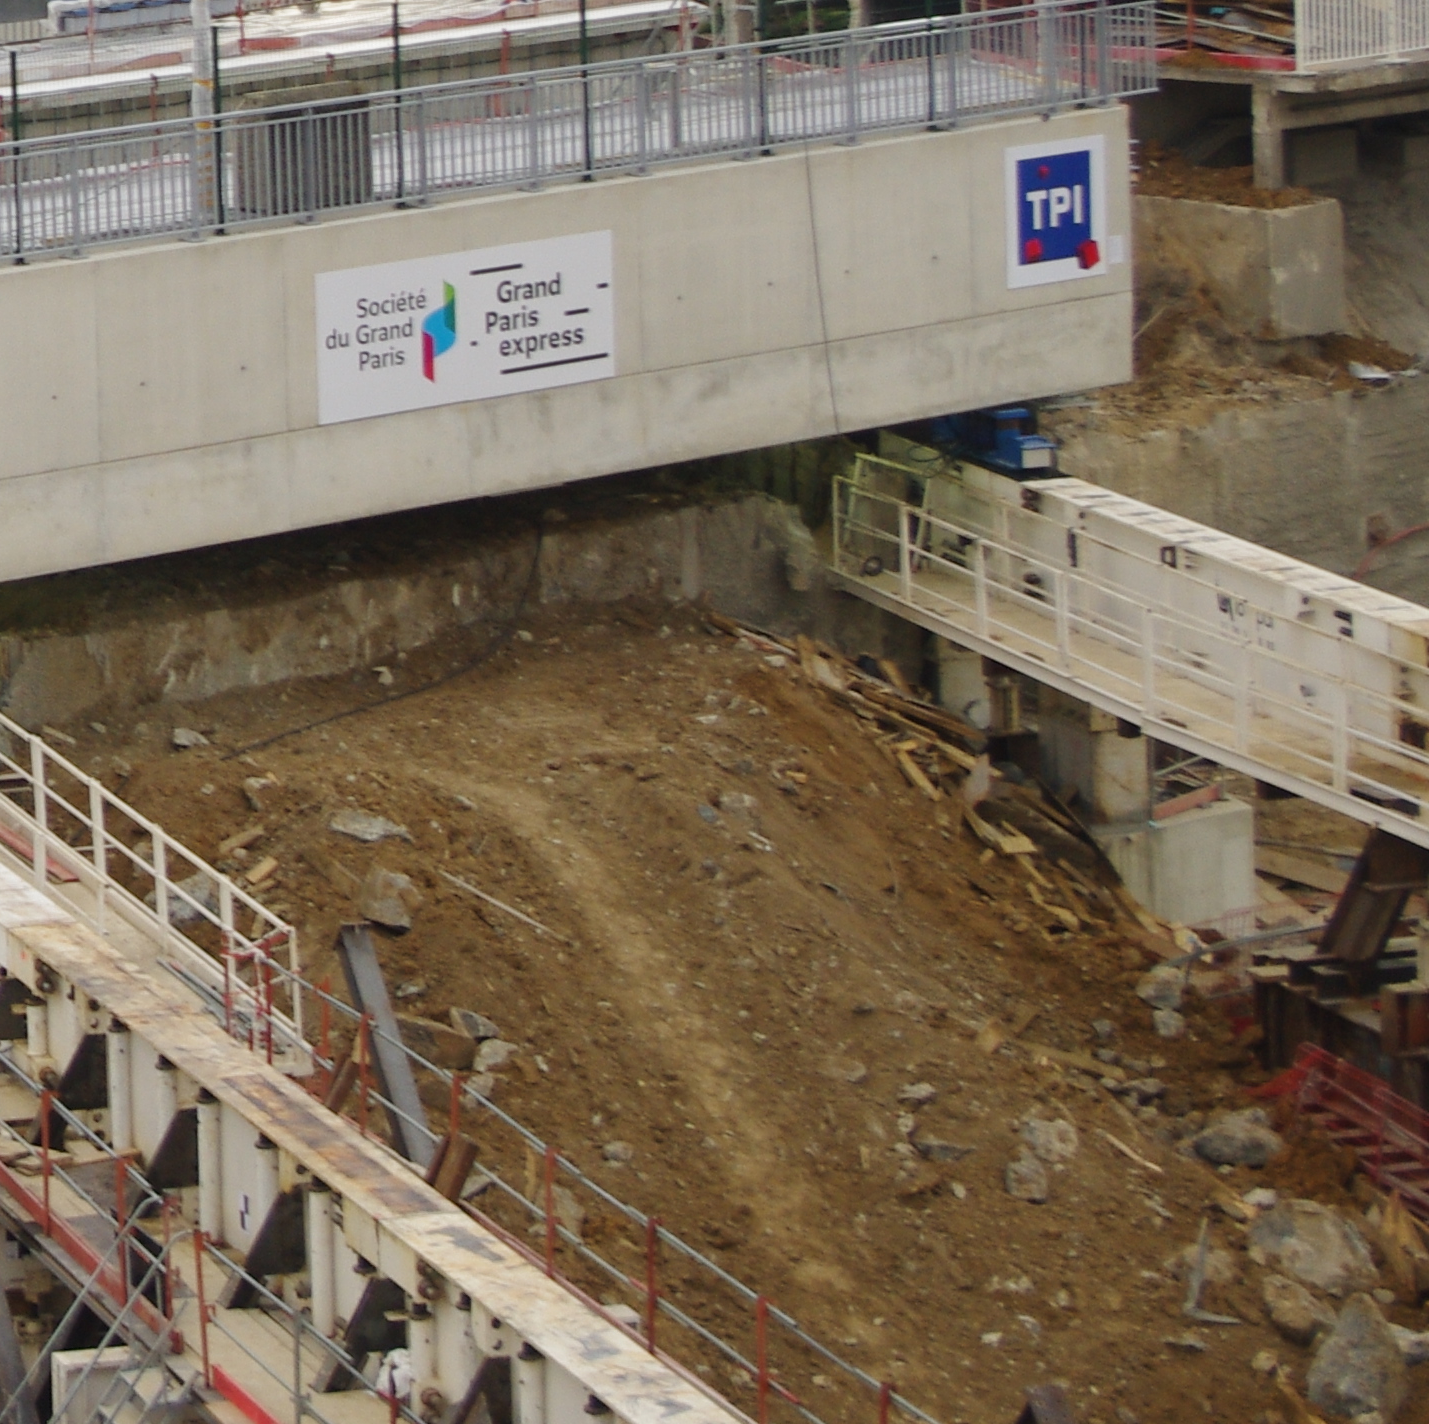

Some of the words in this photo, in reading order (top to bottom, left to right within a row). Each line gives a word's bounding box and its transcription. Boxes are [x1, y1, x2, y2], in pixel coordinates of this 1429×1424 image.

[1025, 184, 1083, 230] TPI
[497, 272, 562, 303] Grand
[356, 288, 427, 319] Société
[325, 328, 350, 350] du
[355, 318, 413, 345] Grand
[485, 305, 539, 334] Paris
[499, 326, 584, 359] express
[359, 348, 405, 371] Paris
